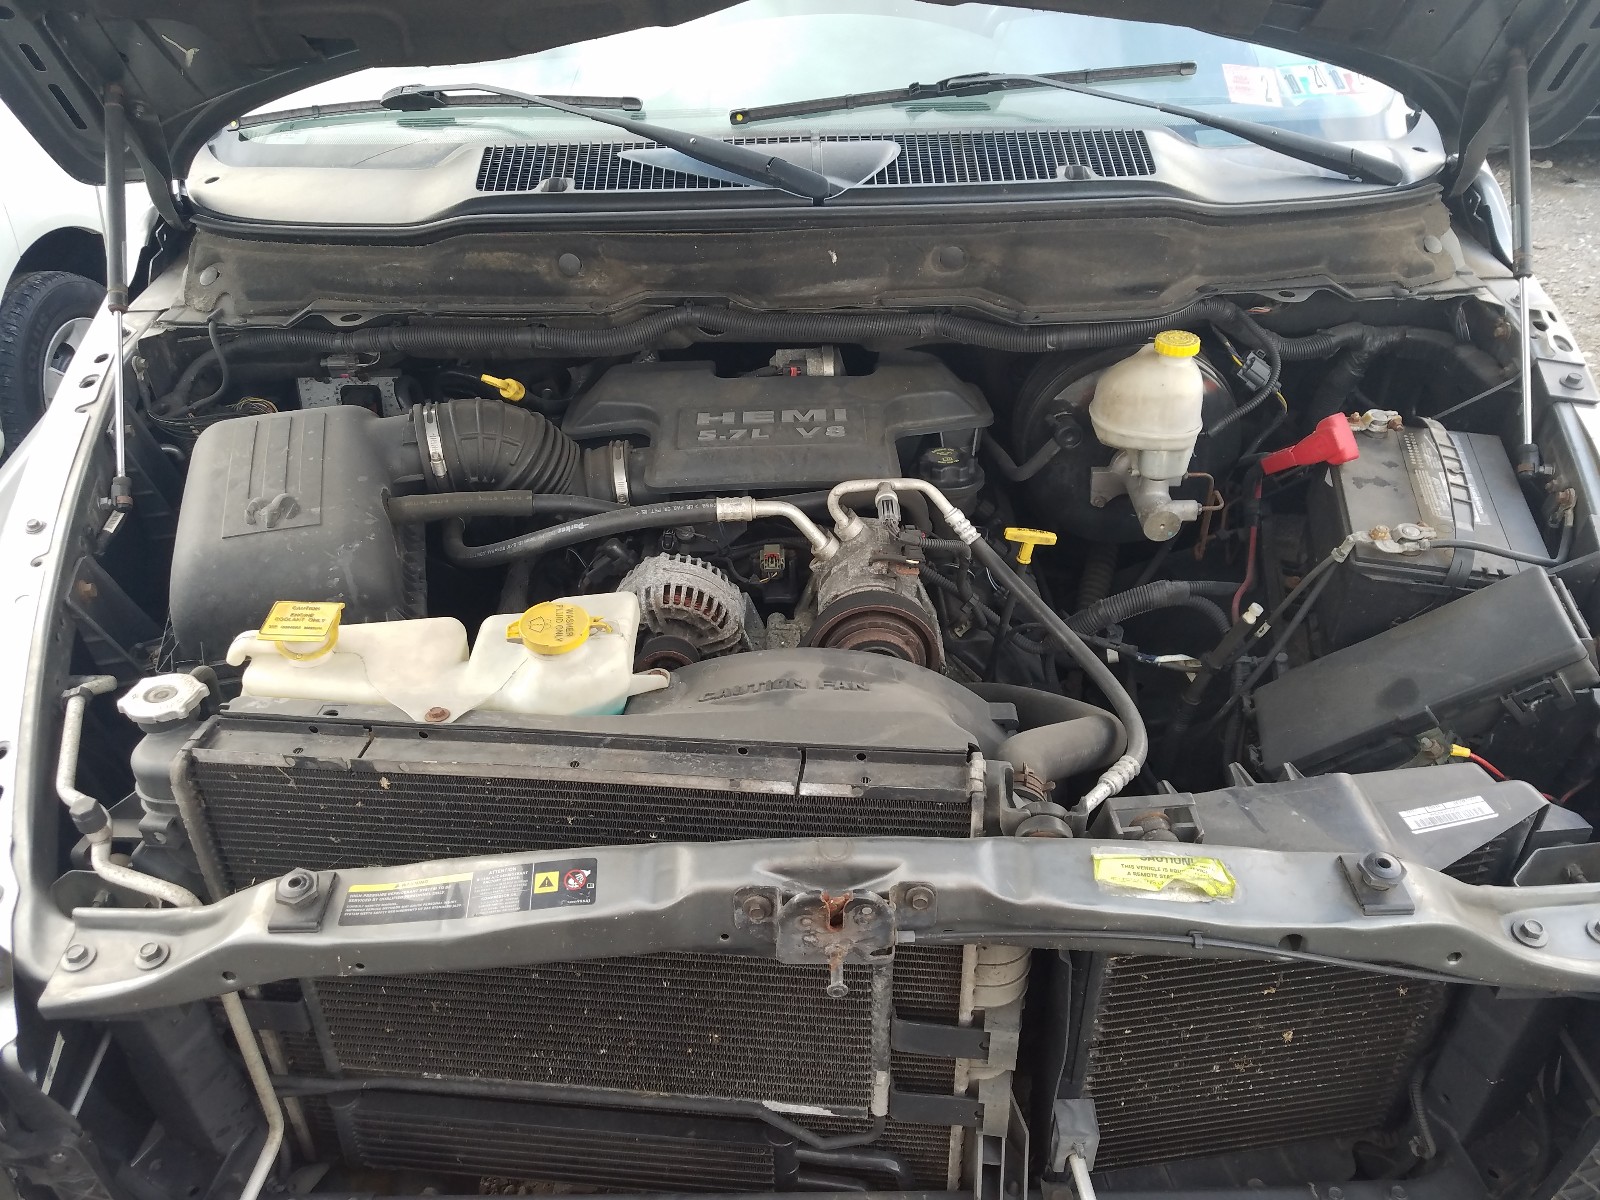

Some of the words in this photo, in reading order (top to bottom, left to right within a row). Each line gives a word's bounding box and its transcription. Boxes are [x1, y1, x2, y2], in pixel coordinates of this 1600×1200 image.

[697, 409, 848, 425] HEMI
[698, 429, 770, 441] 5.7L
[796, 426, 847, 438] V8
[558, 521, 590, 534] Parker
[555, 604, 564, 623] FLUID
[566, 608, 574, 637] WASHER
[555, 625, 564, 642] ONLY
[698, 678, 807, 702] CAUTION
[819, 680, 872, 692] FAN
[489, 866, 517, 875] ATTENTION
